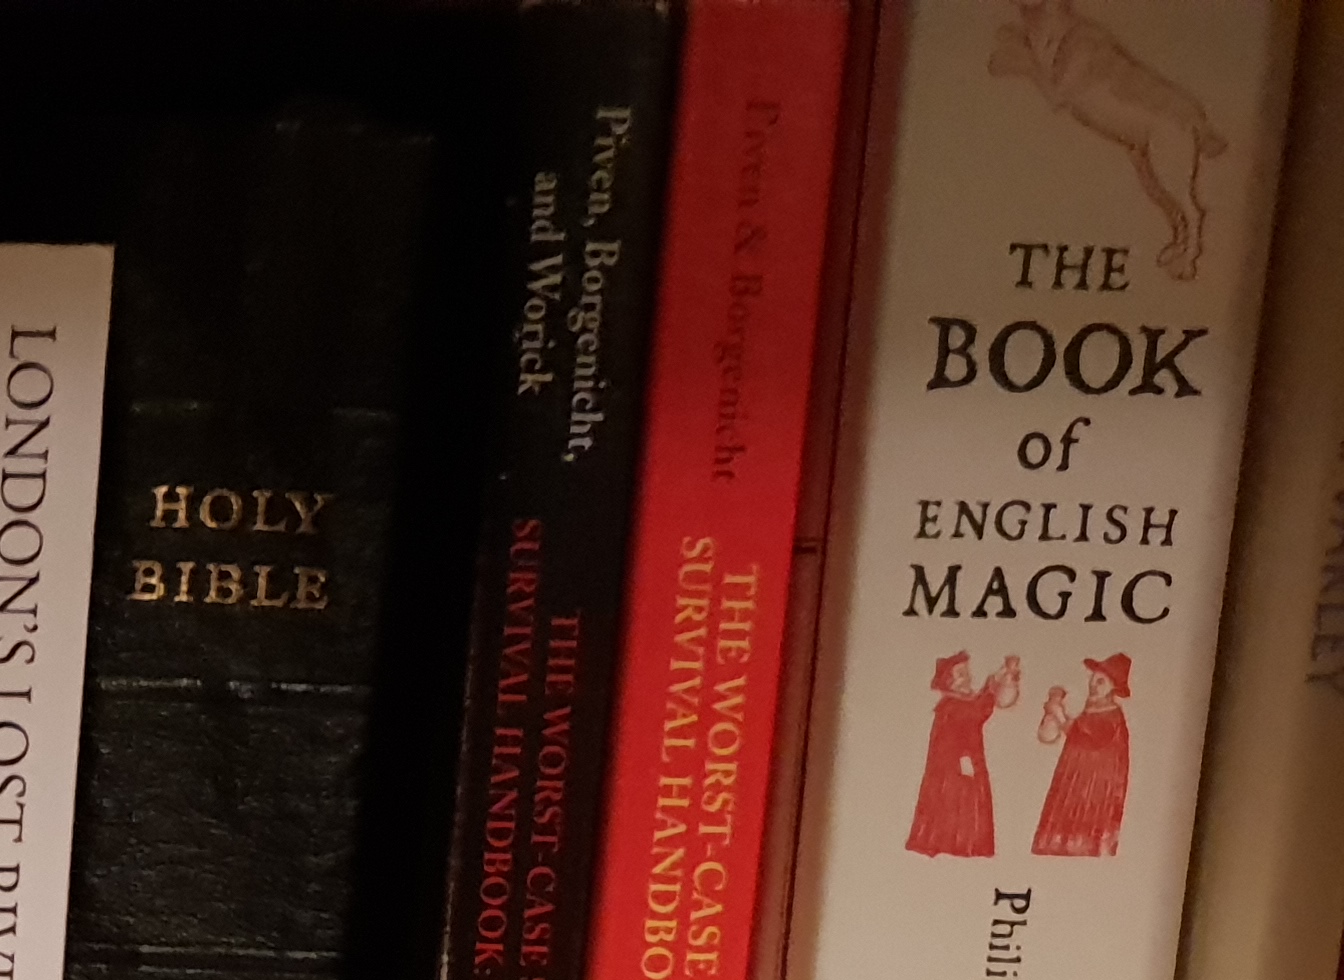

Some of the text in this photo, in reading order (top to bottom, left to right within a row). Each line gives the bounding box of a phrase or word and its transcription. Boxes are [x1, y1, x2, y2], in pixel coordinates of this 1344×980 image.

[511, 171, 568, 398] and Worick
[560, 104, 635, 465] Piven, Borgenicht,
[710, 99, 784, 484] Piven & Borgenicht
[1007, 242, 1133, 292] THE
[925, 315, 1209, 401] BOOK
[1015, 416, 1091, 472] of
[144, 484, 336, 538] HOLY
[914, 498, 1179, 549] ENGLISH
[128, 558, 331, 613] BIBLE
[493, 518, 543, 716] SURVIVAL
[713, 570, 760, 666] THE
[902, 564, 1173, 626] MAGIC
[541, 611, 583, 695] THE
[658, 534, 716, 763] SURVIVAL
[470, 724, 526, 977] HANDBOOK:
[516, 703, 573, 968] WORST-CASE
[682, 675, 740, 978] WORST-CASE
